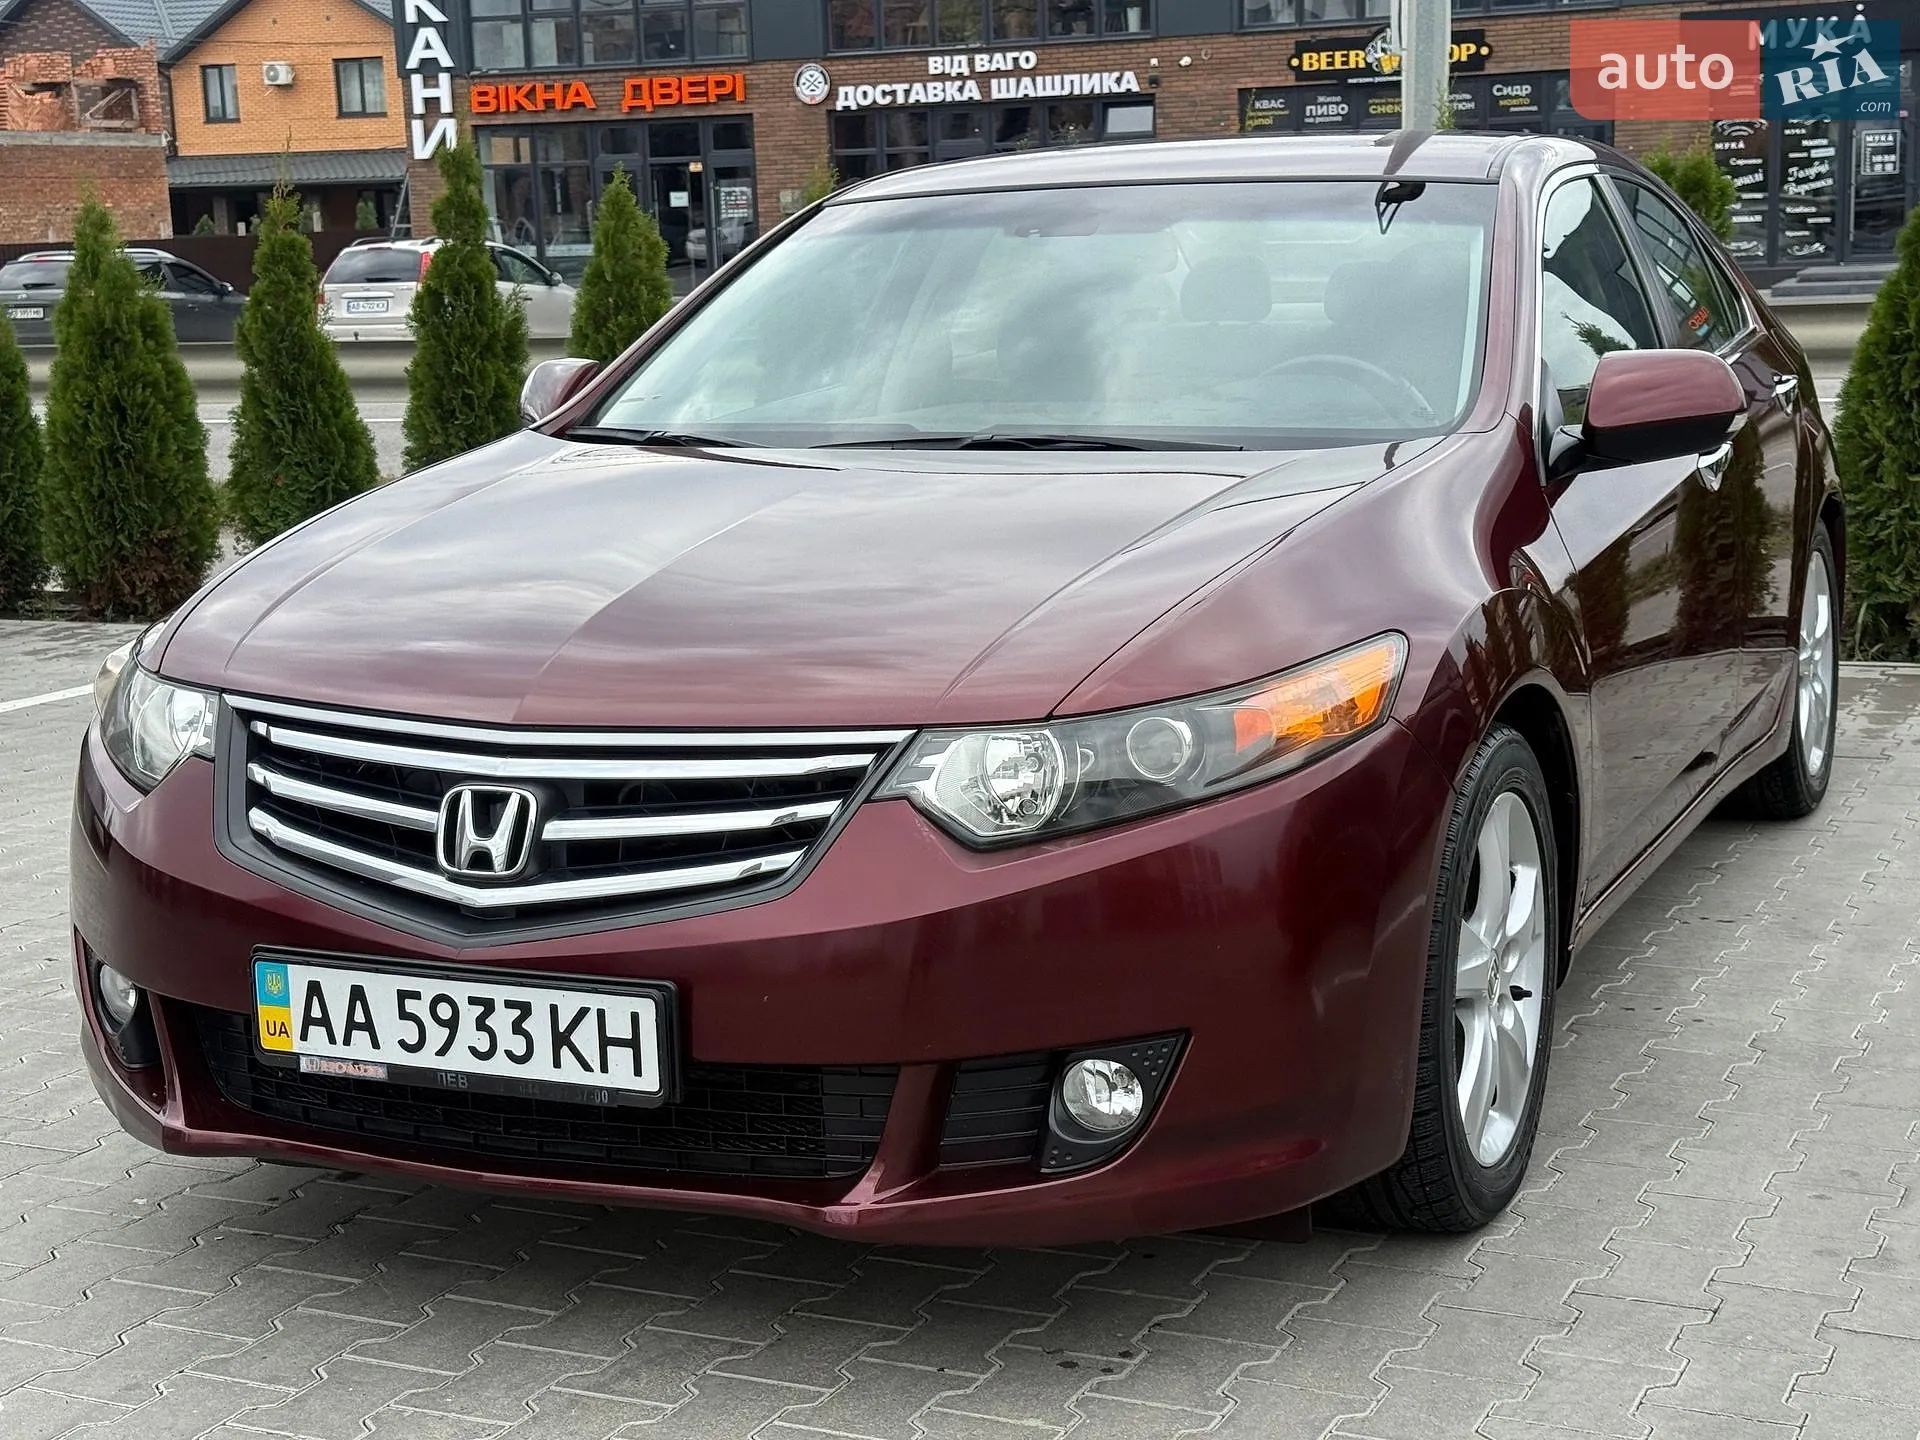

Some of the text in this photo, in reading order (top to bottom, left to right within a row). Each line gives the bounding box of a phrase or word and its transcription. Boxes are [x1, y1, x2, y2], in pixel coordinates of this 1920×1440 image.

[927, 50, 1039, 77] ВІД ВАГО
[1301, 43, 1477, 72] BEER OP
[471, 72, 747, 114] ВІКНА ДВЕРІ
[834, 78, 984, 112] ДОСТАВКА
[989, 70, 1142, 101] ШАШЛИКА
[1254, 98, 1286, 109] КВАС
[1492, 84, 1532, 97] Сидр
[1305, 103, 1349, 117] ПИВО
[266, 1019, 291, 1039] UA
[299, 979, 643, 1078] AA 5933 KH
